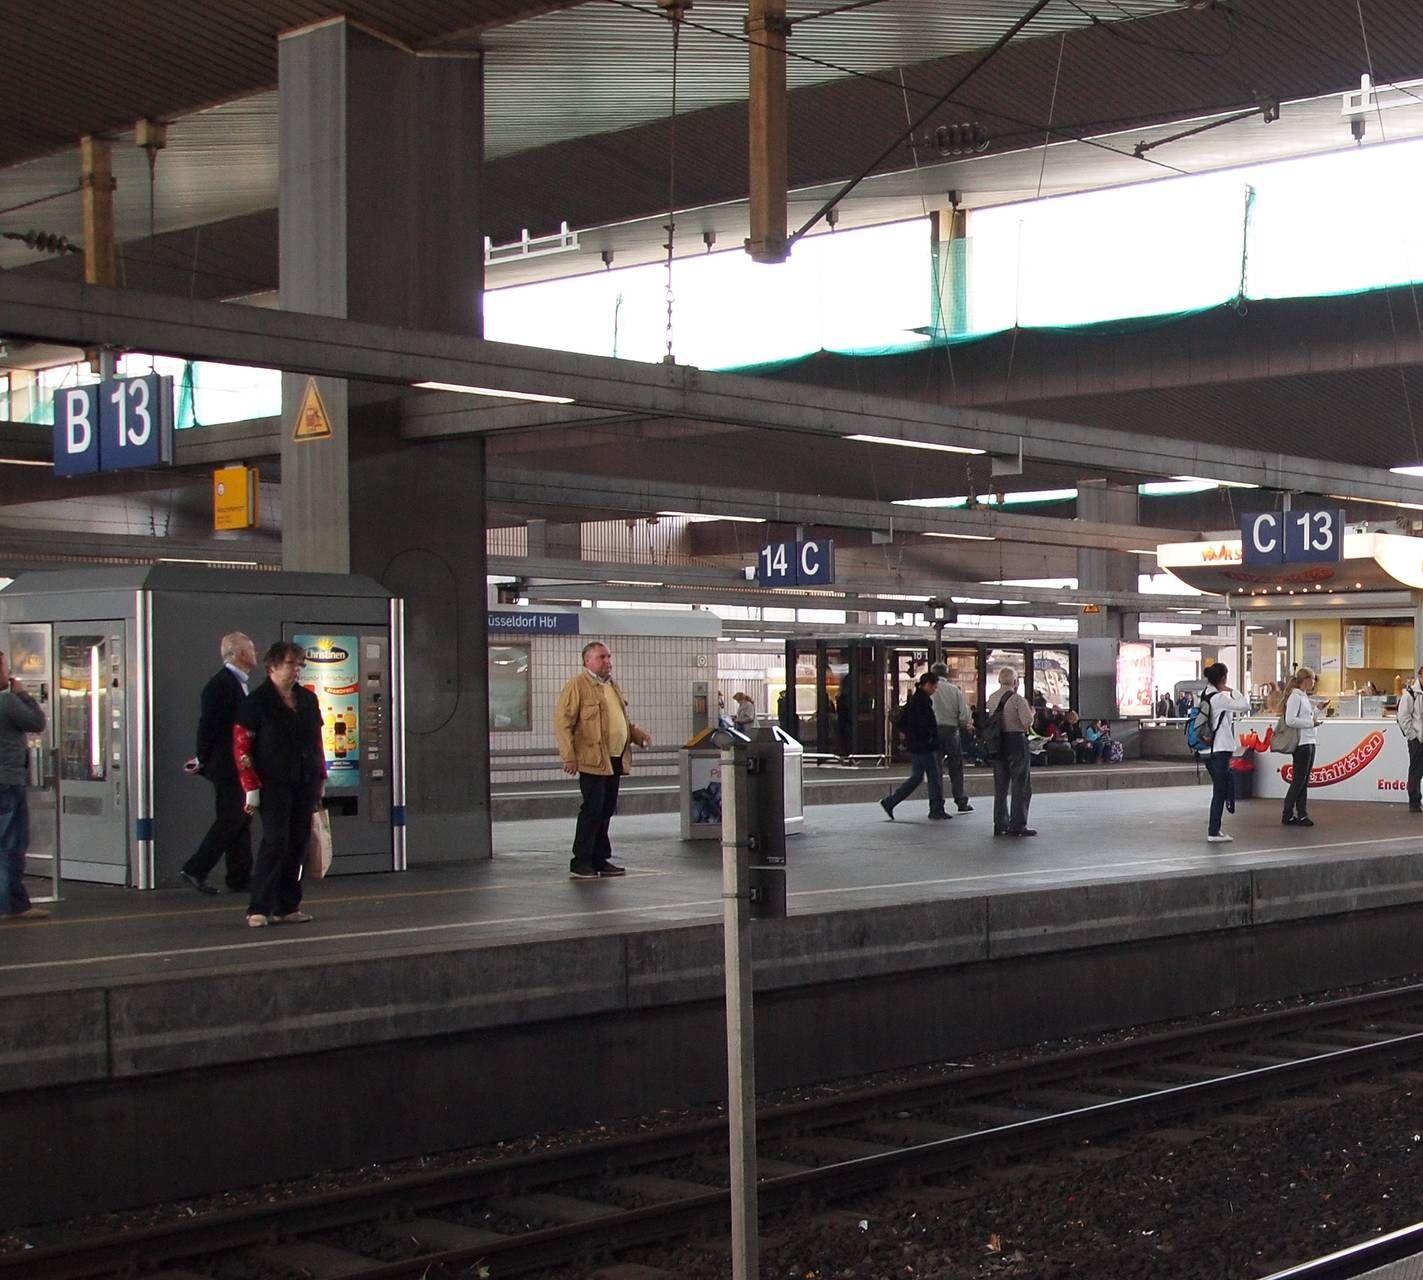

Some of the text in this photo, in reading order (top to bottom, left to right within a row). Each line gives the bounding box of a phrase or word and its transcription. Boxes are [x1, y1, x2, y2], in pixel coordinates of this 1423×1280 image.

[66, 378, 151, 454] B 13
[1252, 511, 1334, 553] C 13
[761, 541, 820, 577] 14 C
[488, 615, 558, 628] üsseldorf Hbf
[1286, 734, 1382, 784] Sezialitäten
[1377, 779, 1408, 791] Ende
